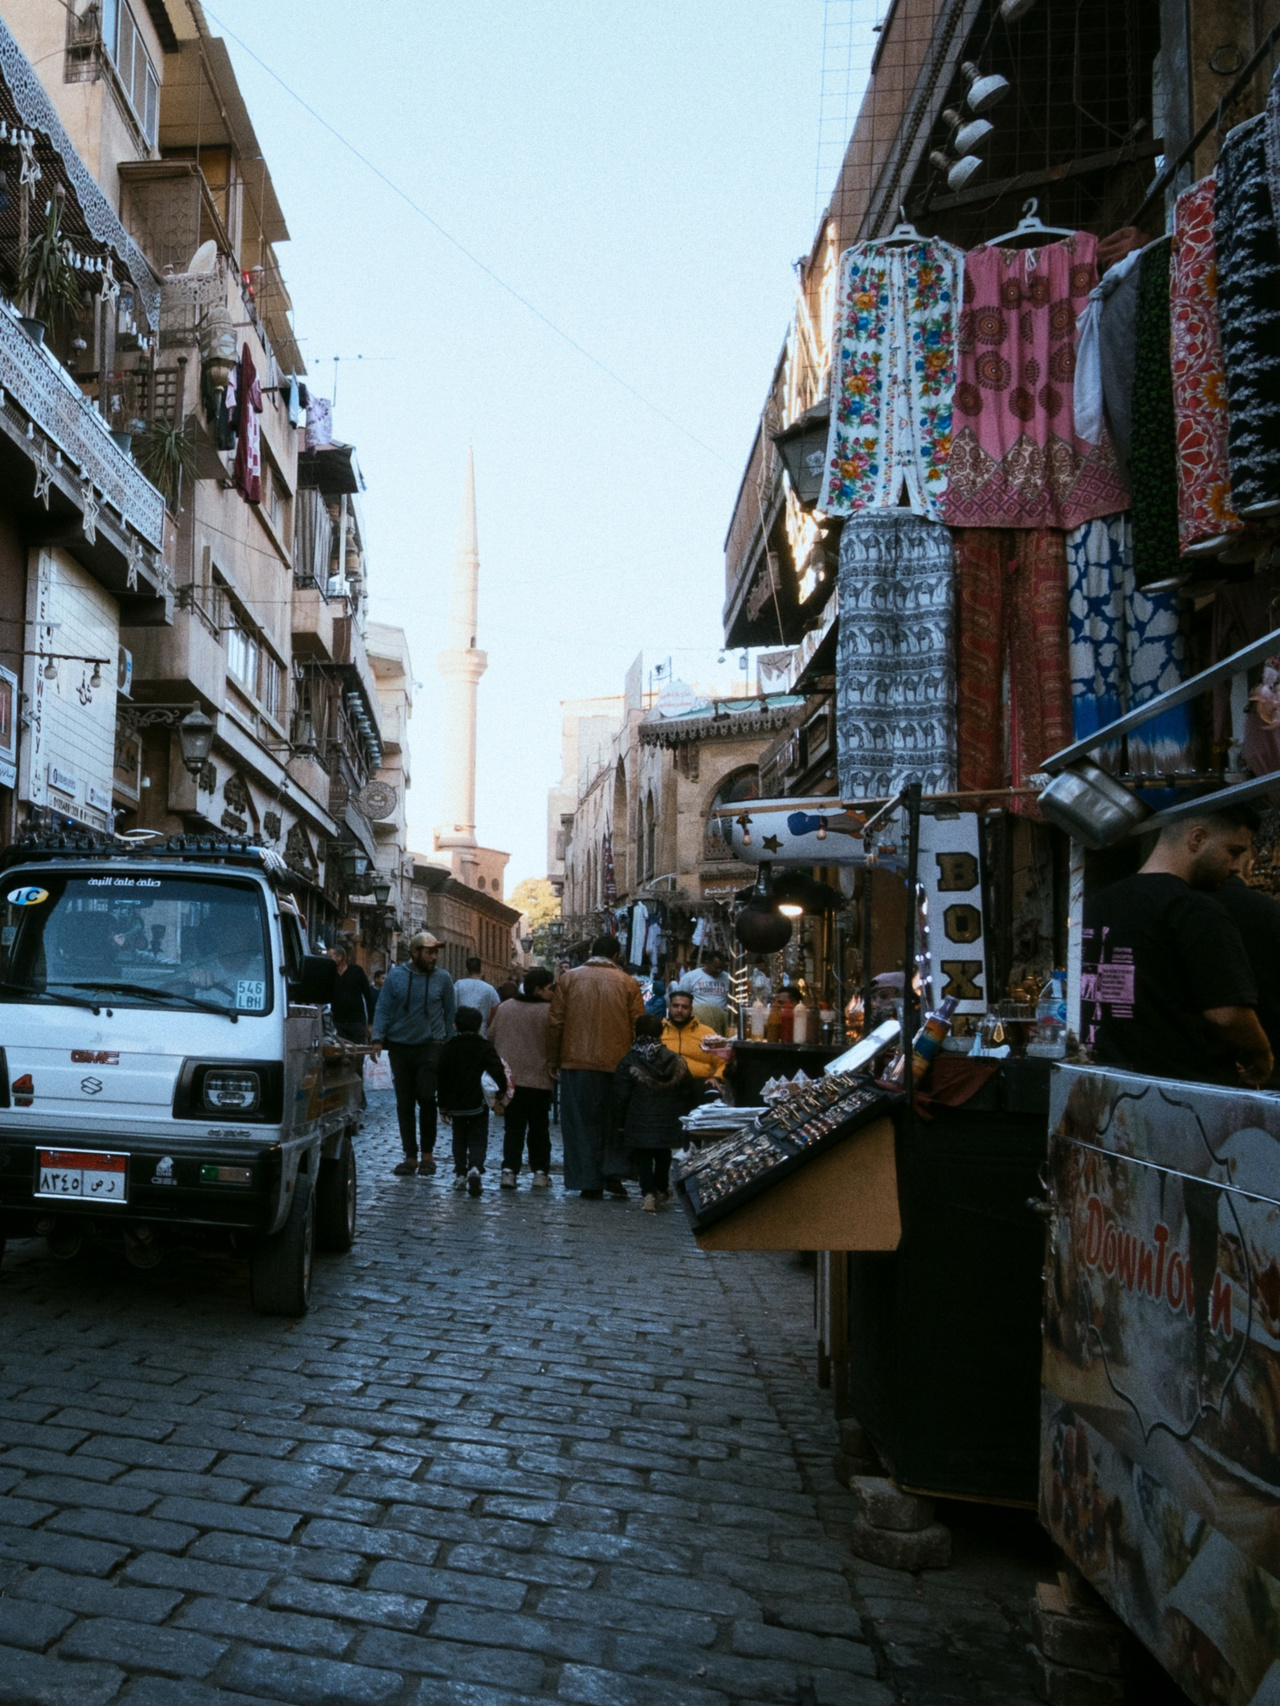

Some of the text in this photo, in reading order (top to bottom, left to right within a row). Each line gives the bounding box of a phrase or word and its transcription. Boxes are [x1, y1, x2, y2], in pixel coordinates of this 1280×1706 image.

[238, 981, 263, 995] 546
[238, 995, 262, 1009] LBH
[70, 1049, 119, 1065] GMC
